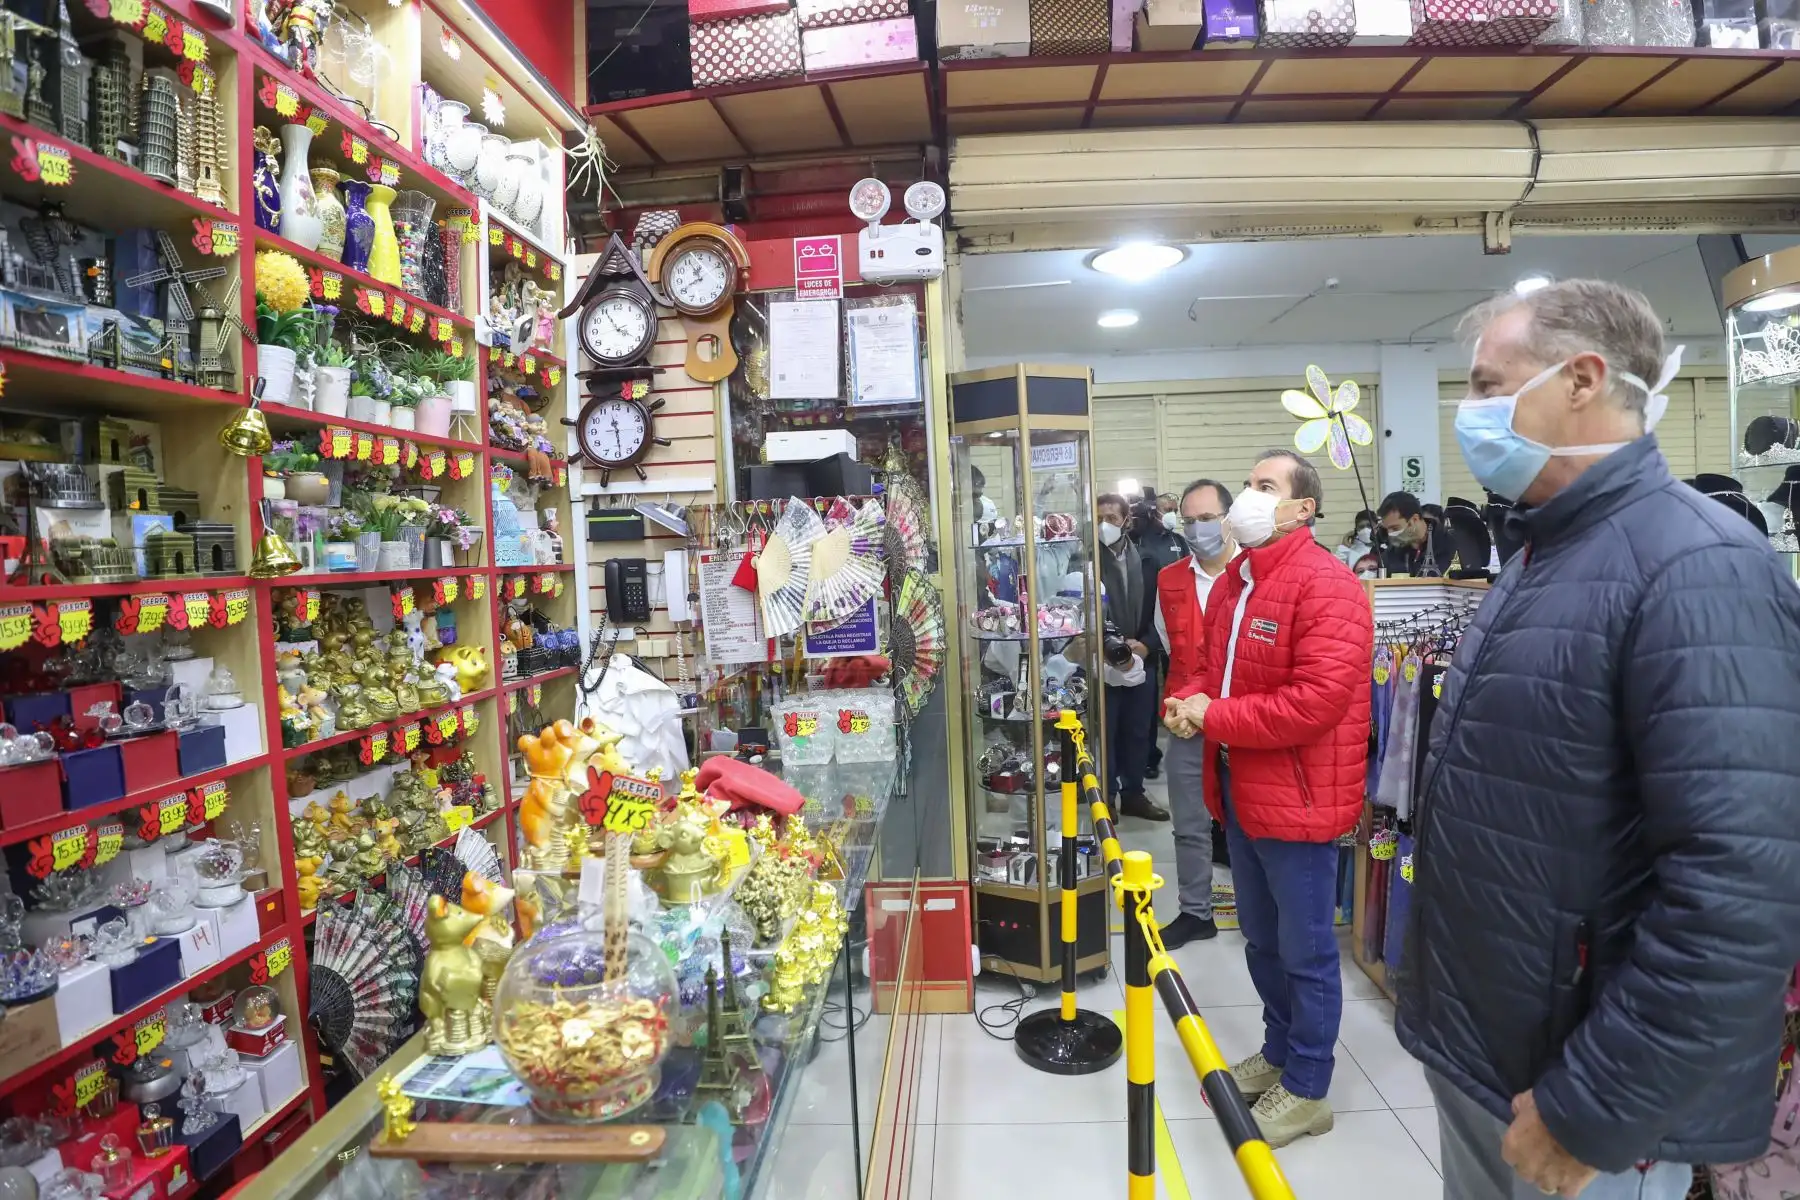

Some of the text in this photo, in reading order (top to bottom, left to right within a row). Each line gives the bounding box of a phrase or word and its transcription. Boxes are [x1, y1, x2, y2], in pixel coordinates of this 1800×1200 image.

[803, 279, 832, 288] LUCES DE
[799, 287, 838, 297] EMERGENCIA
[1407, 458, 1420, 478] S
[184, 593, 208, 601] OFERTA
[226, 590, 249, 600] OFERTA
[60, 601, 90, 612] OFERTA
[141, 597, 168, 606] OFERTA
[0, 605, 33, 617] FERTA
[204, 783, 225, 795] OFERTA
[613, 779, 659, 798] OFERTA
[159, 793, 186, 809] OFERTA
[52, 825, 88, 842] OFERTA
[98, 825, 123, 836] OFERTA
[265, 939, 290, 956] OFERTA
[135, 1009, 165, 1029] OFERTA
